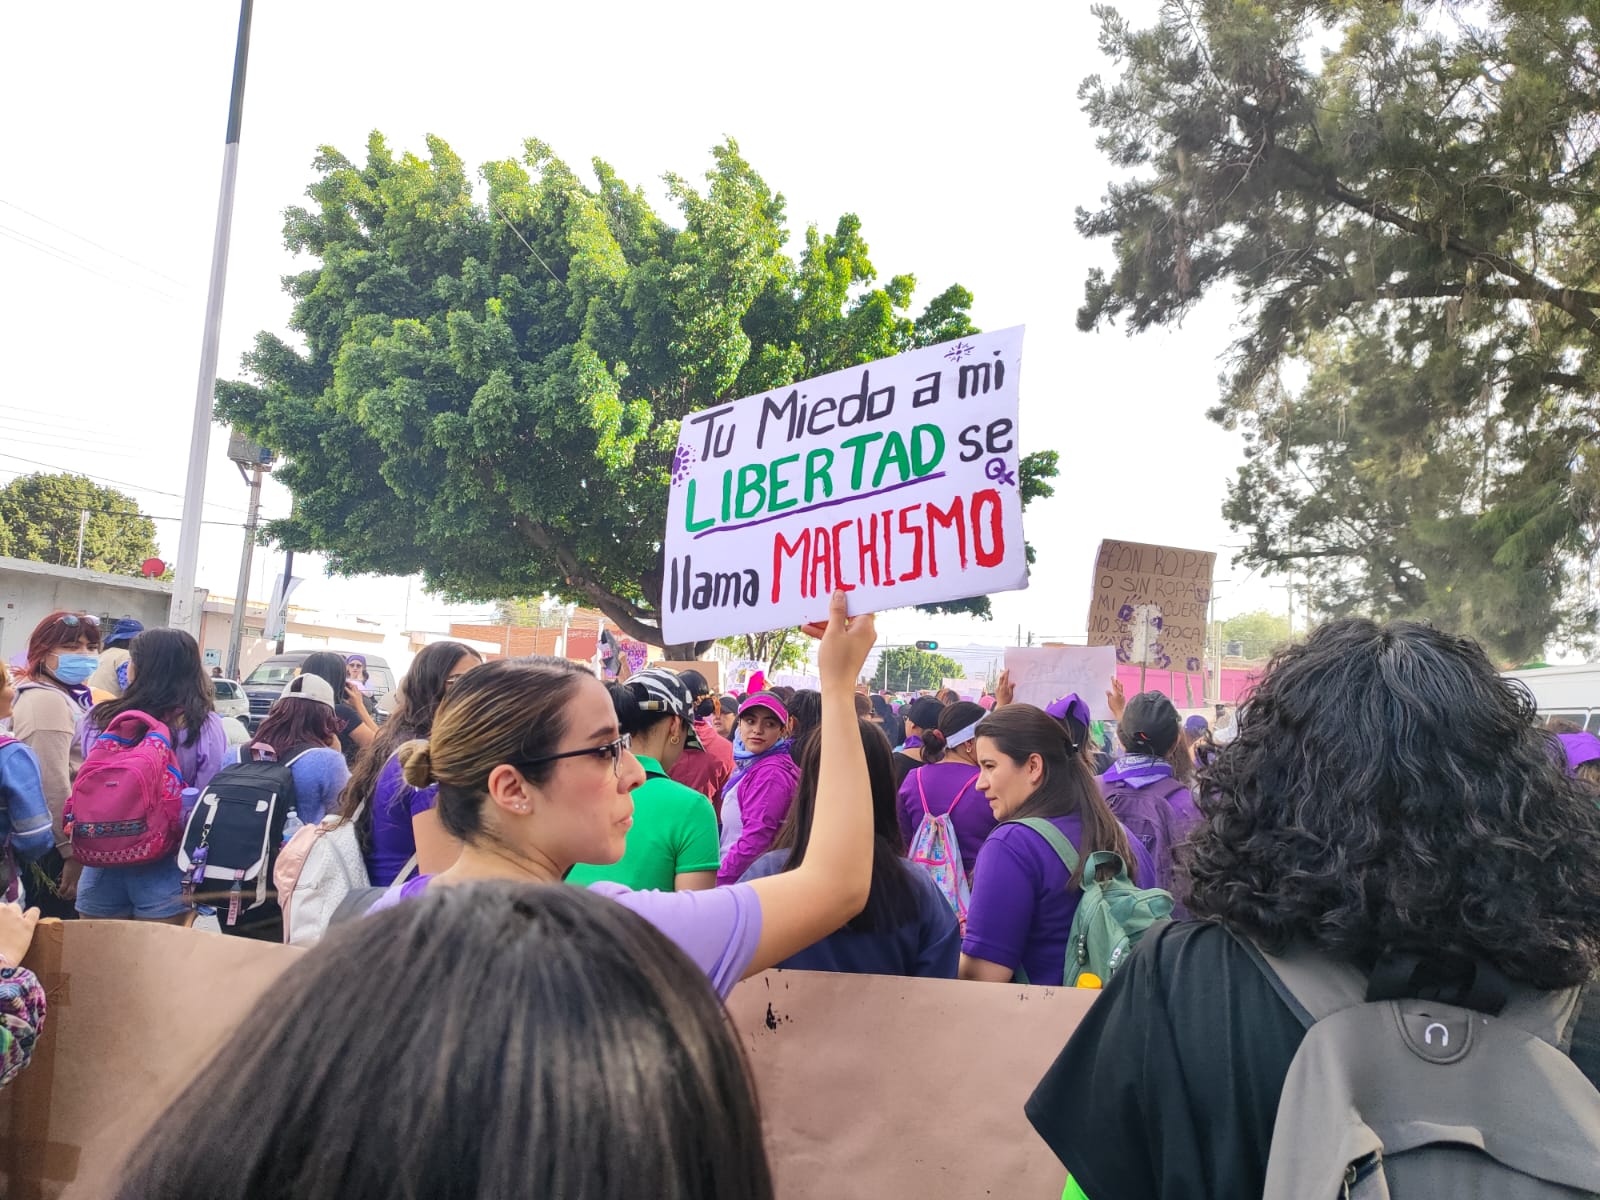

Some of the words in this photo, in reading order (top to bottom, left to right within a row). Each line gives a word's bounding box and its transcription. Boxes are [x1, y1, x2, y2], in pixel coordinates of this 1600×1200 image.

[691, 406, 736, 462] Tu
[756, 369, 896, 450] Miedo
[912, 371, 942, 410] a
[957, 350, 1005, 400] mi
[684, 422, 946, 534] LIBERTAD
[957, 417, 1014, 463] se
[669, 554, 760, 614] llama
[770, 488, 1005, 604] MACHISMO
[1153, 546, 1211, 580] ROPA
[1100, 575, 1114, 589] O
[1119, 576, 1151, 595] SIN
[1096, 594, 1116, 611] MI
[1091, 615, 1110, 633] NO
[1162, 623, 1201, 642] TOCA
